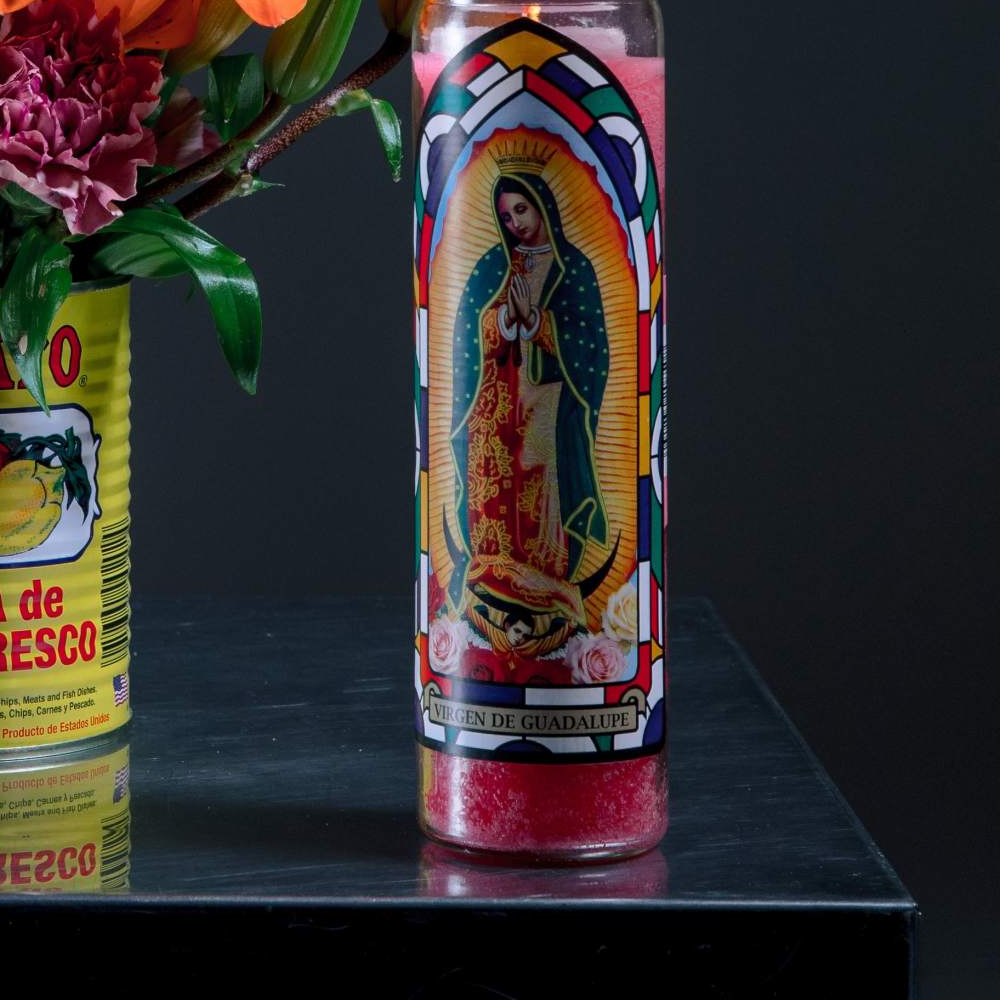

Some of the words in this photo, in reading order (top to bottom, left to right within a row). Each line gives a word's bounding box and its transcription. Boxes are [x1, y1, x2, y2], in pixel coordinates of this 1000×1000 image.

[19, 579, 64, 620] de
[9, 706, 34, 718] Chips,
[36, 704, 62, 715] Carnes
[69, 698, 96, 711] Pescado.
[23, 694, 45, 705] Meats
[47, 692, 61, 702] and
[62, 689, 76, 699] Fish
[2, 725, 45, 739] Producto
[47, 724, 58, 735] de
[60, 719, 89, 733] Estados
[90, 712, 110, 727] Unidos
[433, 703, 487, 725] VIRGEN
[491, 712, 516, 729] DE
[521, 712, 630, 730] GUADALUPE
